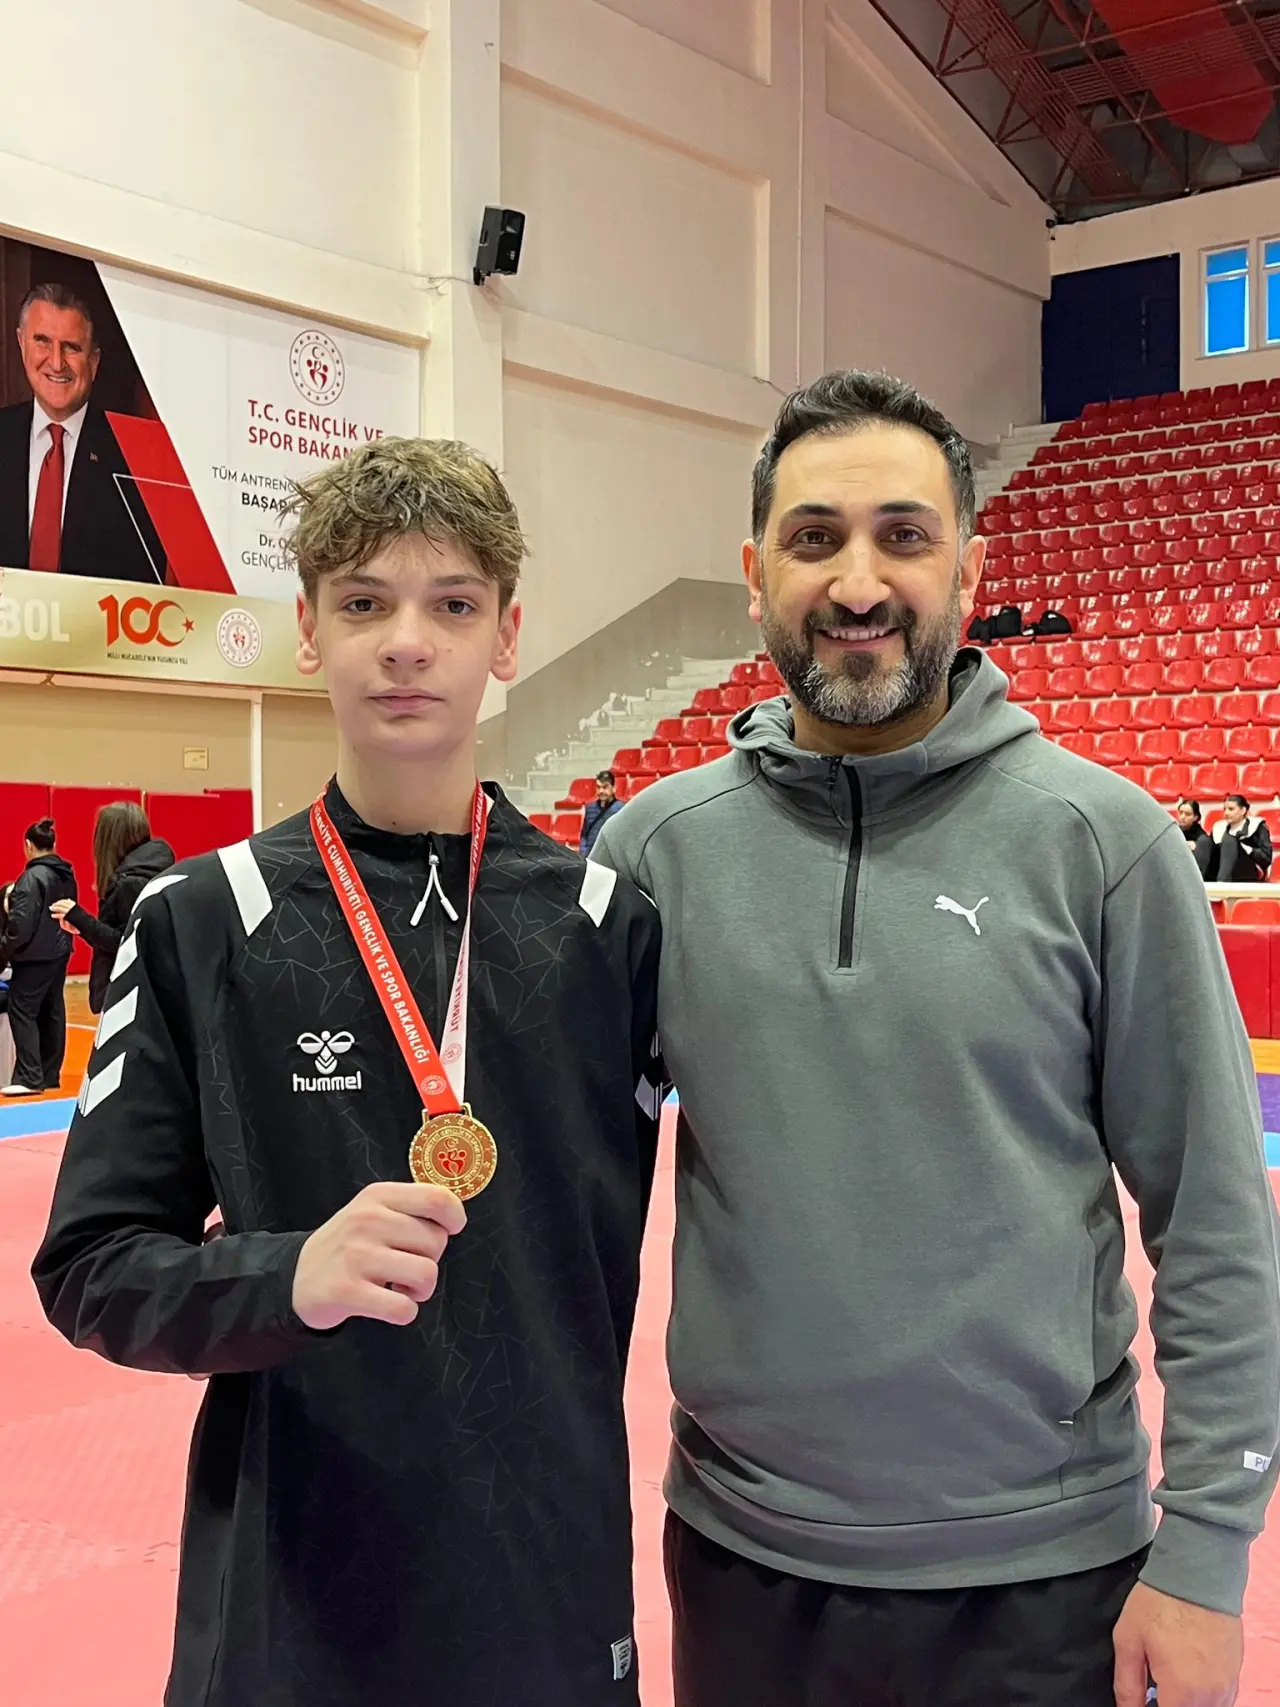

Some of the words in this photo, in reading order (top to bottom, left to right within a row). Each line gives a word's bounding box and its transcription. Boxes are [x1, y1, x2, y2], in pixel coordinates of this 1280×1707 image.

[248, 399, 279, 423] T.C.
[284, 408, 358, 440] GENÇLİK
[248, 426, 293, 452] SPOR
[212, 465, 237, 482] TÜM
[259, 533, 276, 548] Dr.
[327, 844, 366, 911] CUMHURİYETİ
[355, 910, 384, 956] GENÇLİK
[375, 955, 389, 971] VE
[381, 970, 402, 1000] SPOR
[393, 1000, 430, 1064] BAKANLIĞI
[293, 1070, 362, 1092] hummel
